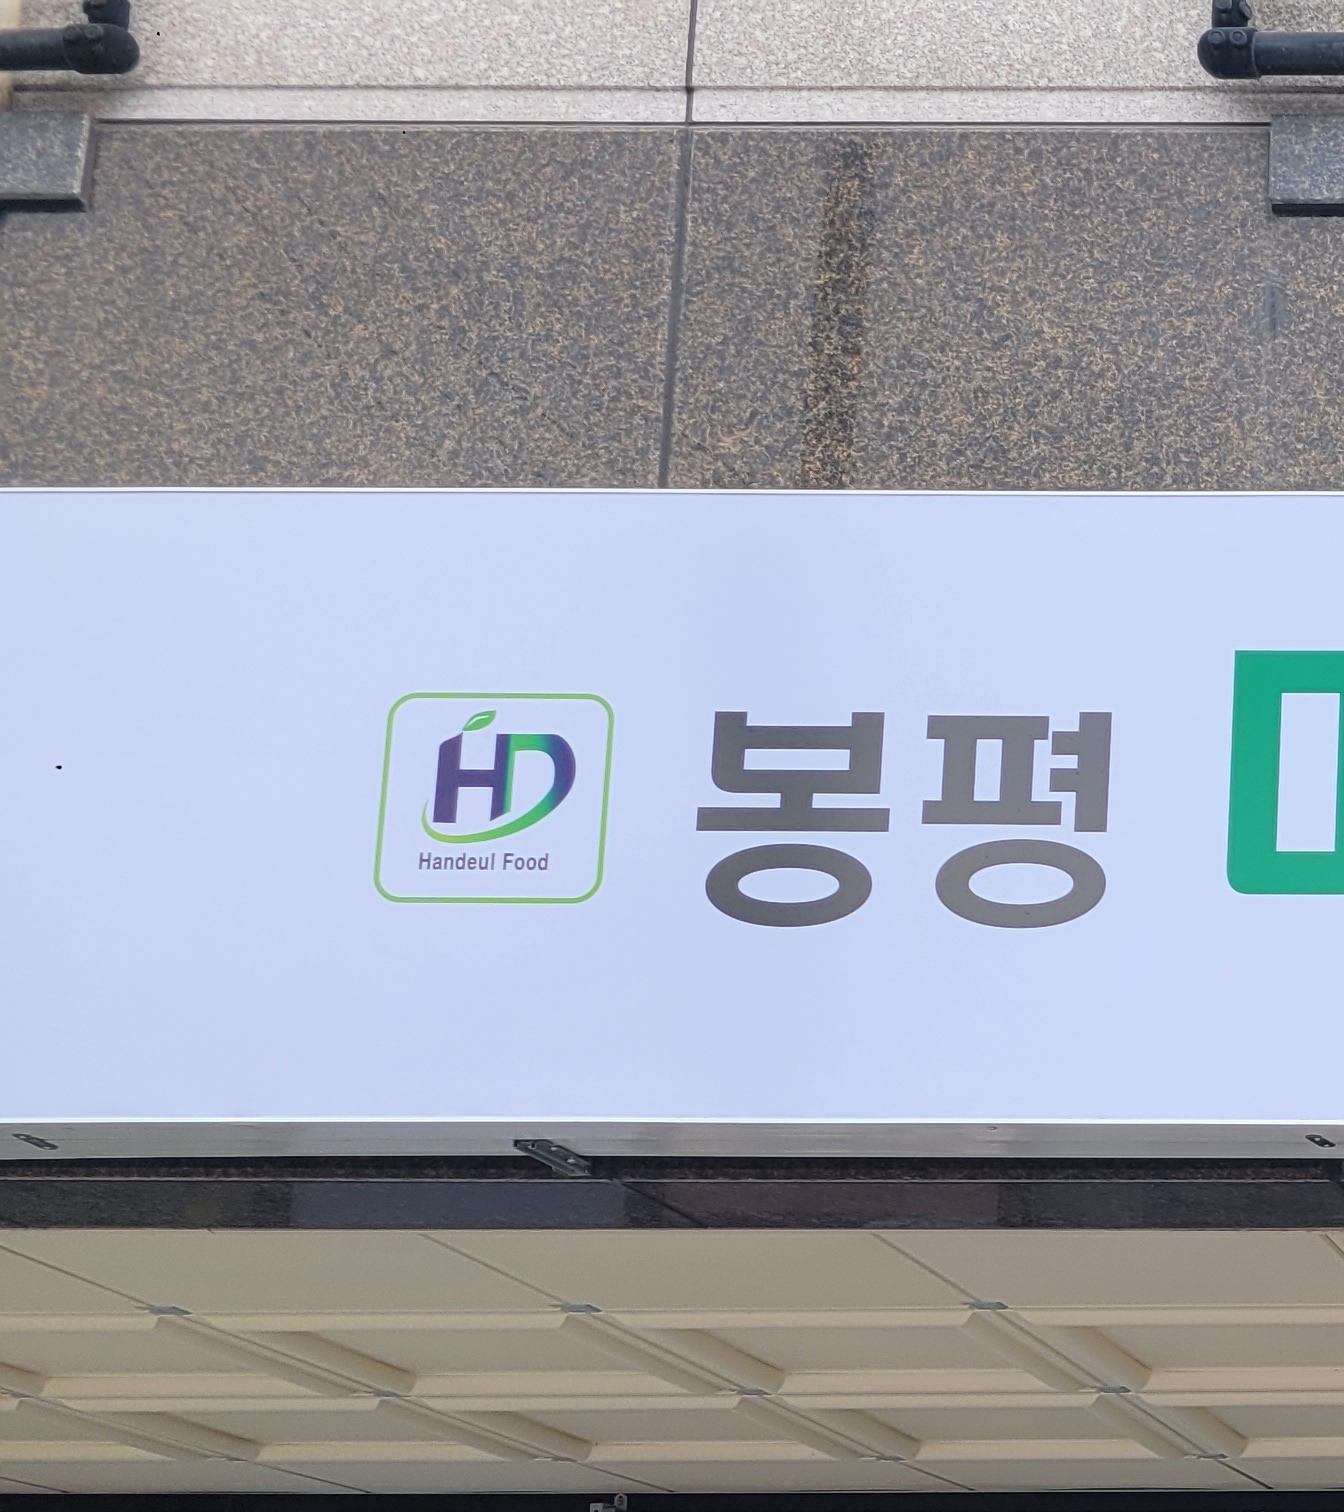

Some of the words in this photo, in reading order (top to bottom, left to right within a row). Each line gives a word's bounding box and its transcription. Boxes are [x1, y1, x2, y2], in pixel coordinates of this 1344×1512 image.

[422, 729, 577, 844] HD
[696, 711, 1113, 928] 봉평
[417, 851, 496, 872] Handeul
[502, 851, 549, 872] Food
